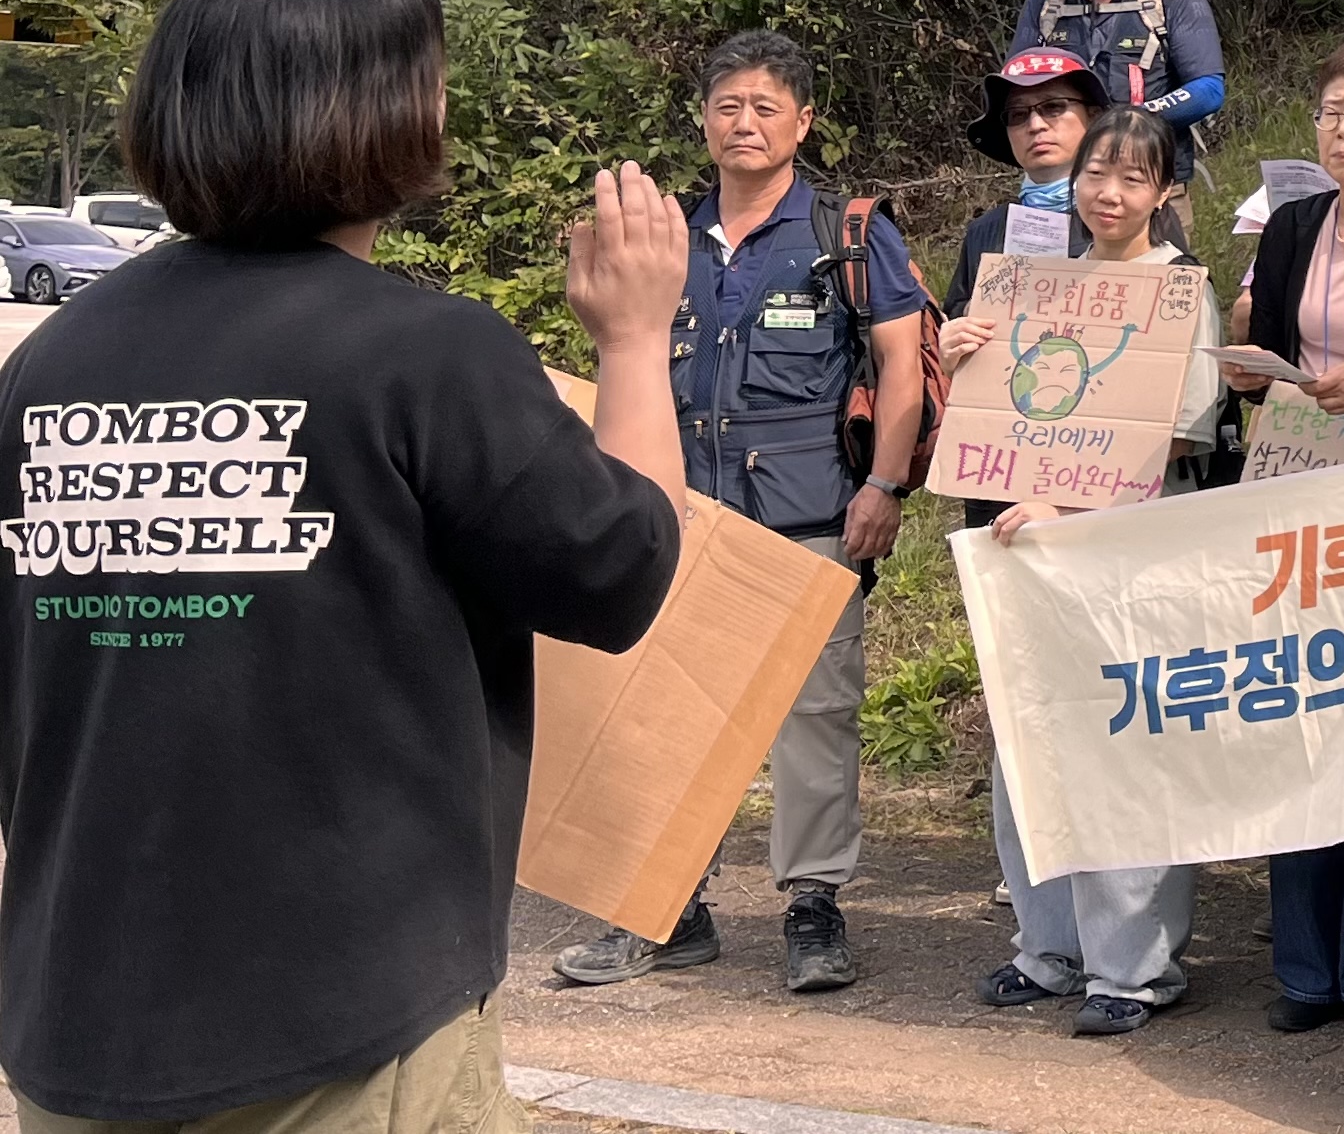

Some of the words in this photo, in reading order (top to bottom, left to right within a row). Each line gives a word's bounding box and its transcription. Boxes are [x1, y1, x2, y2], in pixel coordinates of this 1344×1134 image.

[1034, 277, 1130, 321] 일회용품
[27, 400, 303, 449] TOMBOY
[1005, 420, 1115, 456] 우리에게
[1268, 399, 1337, 441] 건강한
[24, 460, 304, 505] RESPECT
[956, 442, 1017, 491] 다시
[5, 515, 333, 561] YOURSELF
[35, 595, 121, 621] STUDIO
[127, 594, 254, 619] TOMBOY
[90, 631, 131, 648] SINCE
[138, 632, 185, 648] 1977
